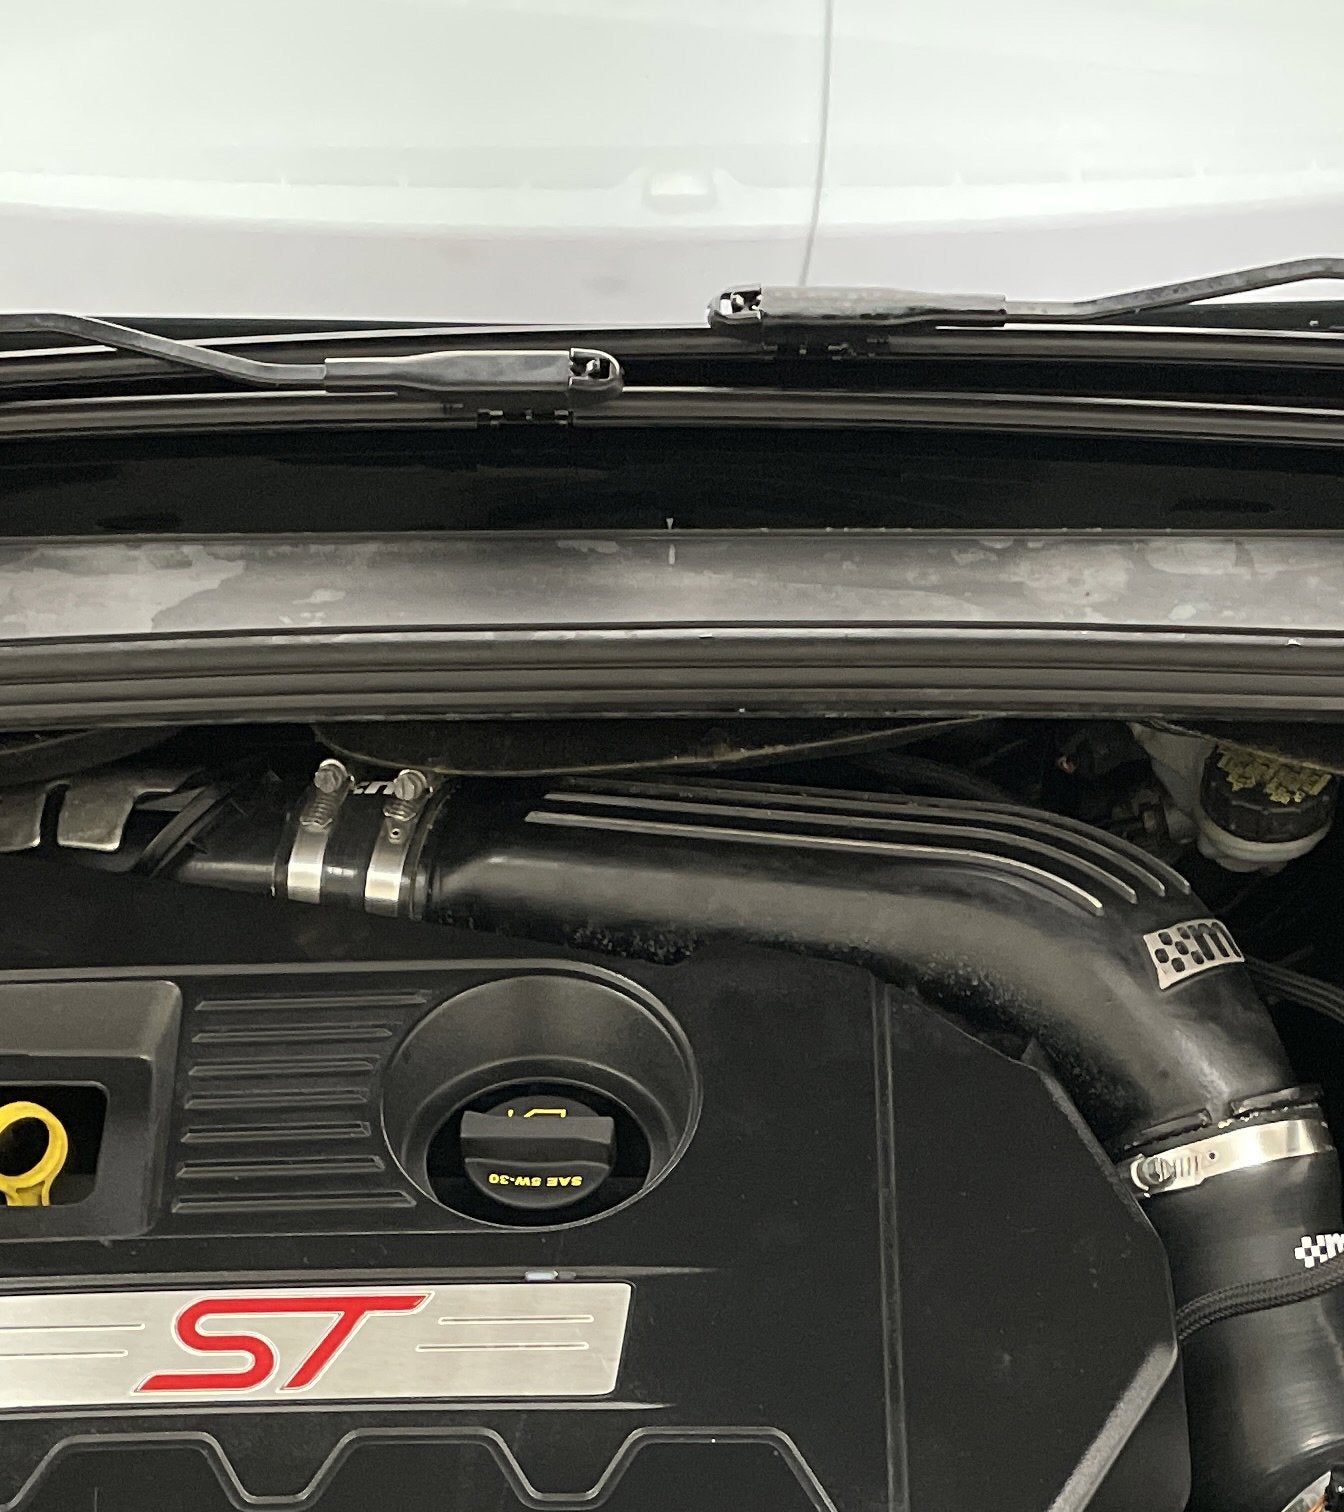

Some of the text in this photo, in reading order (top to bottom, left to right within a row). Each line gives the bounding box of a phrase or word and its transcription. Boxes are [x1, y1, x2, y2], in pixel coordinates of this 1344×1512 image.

[488, 1173, 583, 1187] SAE 5W-30
[133, 1292, 435, 1393] ST
